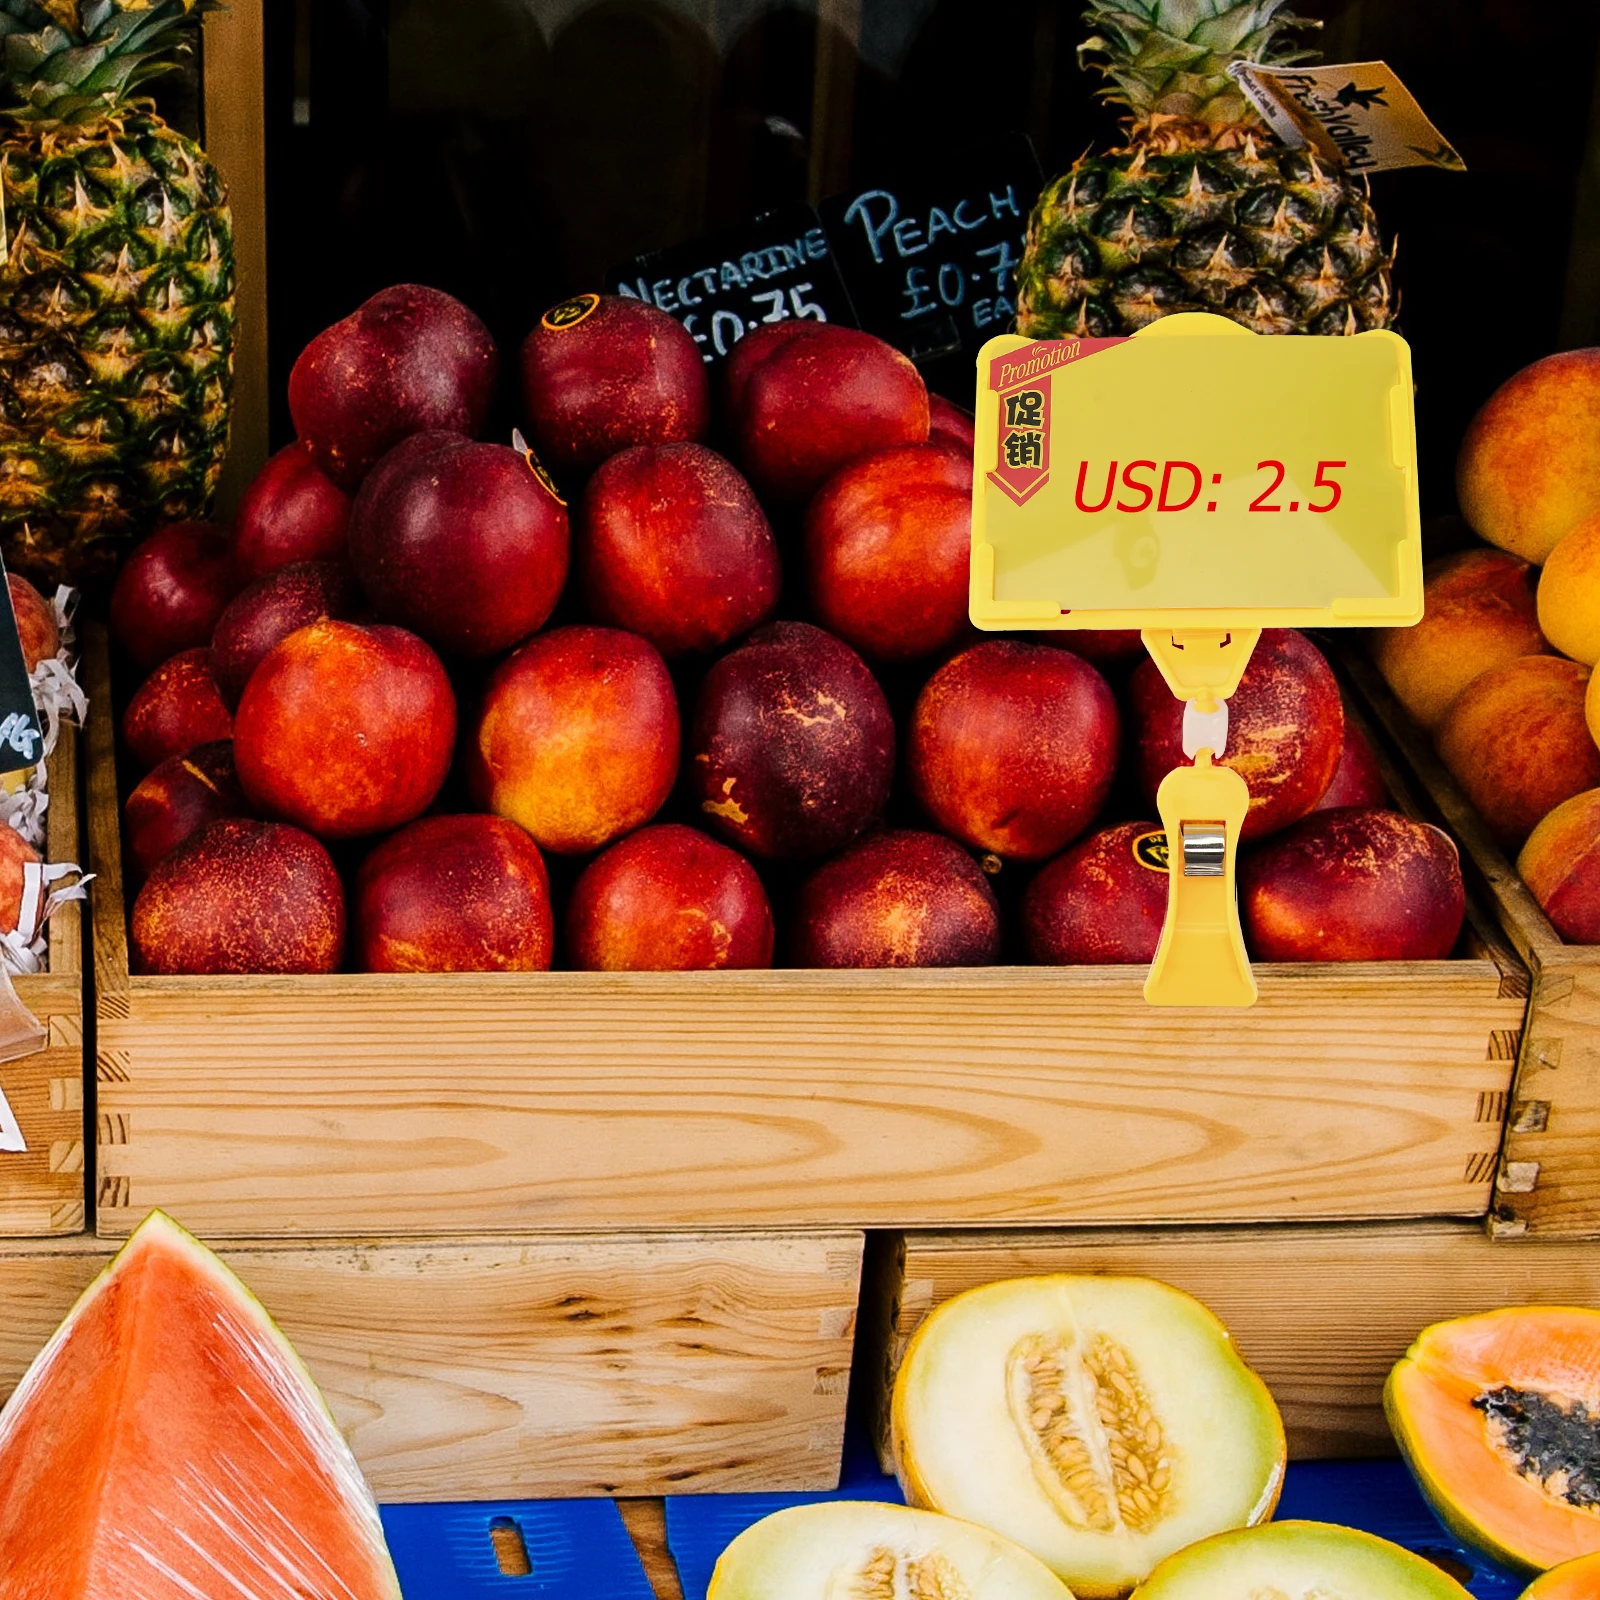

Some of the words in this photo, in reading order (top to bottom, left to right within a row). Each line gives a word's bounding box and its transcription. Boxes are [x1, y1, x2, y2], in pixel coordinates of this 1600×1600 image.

[844, 184, 1021, 264] PEACH
[618, 227, 829, 313] NECTARINE
[901, 233, 1027, 319] £0.7
[998, 339, 1081, 387] Promotion
[1004, 389, 1045, 469] 促销
[1074, 460, 1222, 513] USD:
[1248, 460, 1347, 513] 2.5
